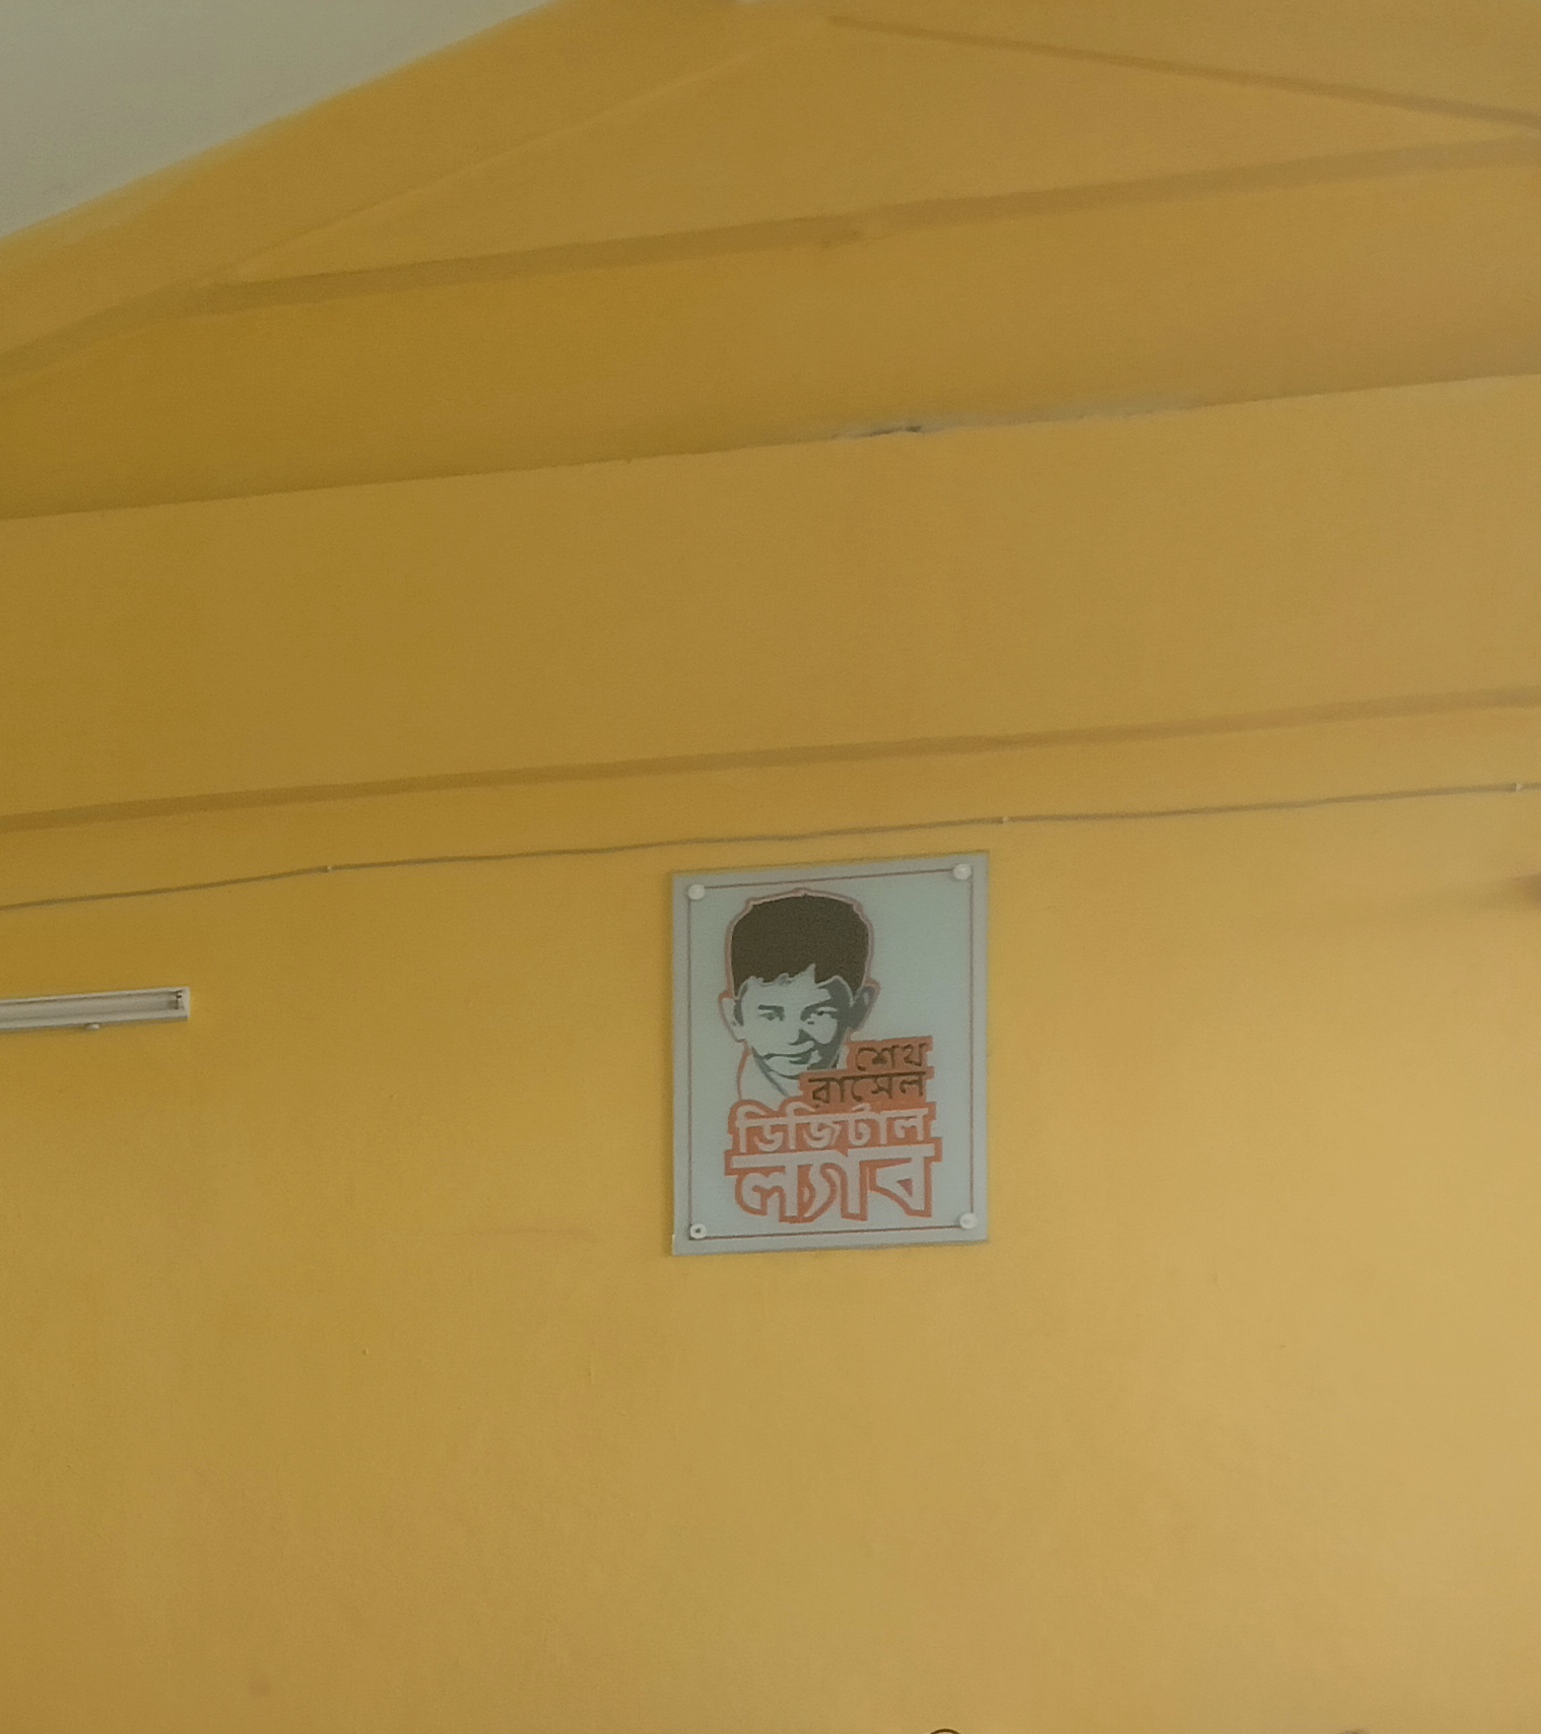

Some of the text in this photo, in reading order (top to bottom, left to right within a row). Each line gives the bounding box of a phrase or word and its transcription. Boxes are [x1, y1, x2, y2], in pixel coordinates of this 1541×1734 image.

[855, 1042, 929, 1072] শেখ
[807, 1070, 927, 1108] রাসেল
[735, 1102, 929, 1153] ডিজিটাল
[730, 1143, 935, 1219] ল্যাব
